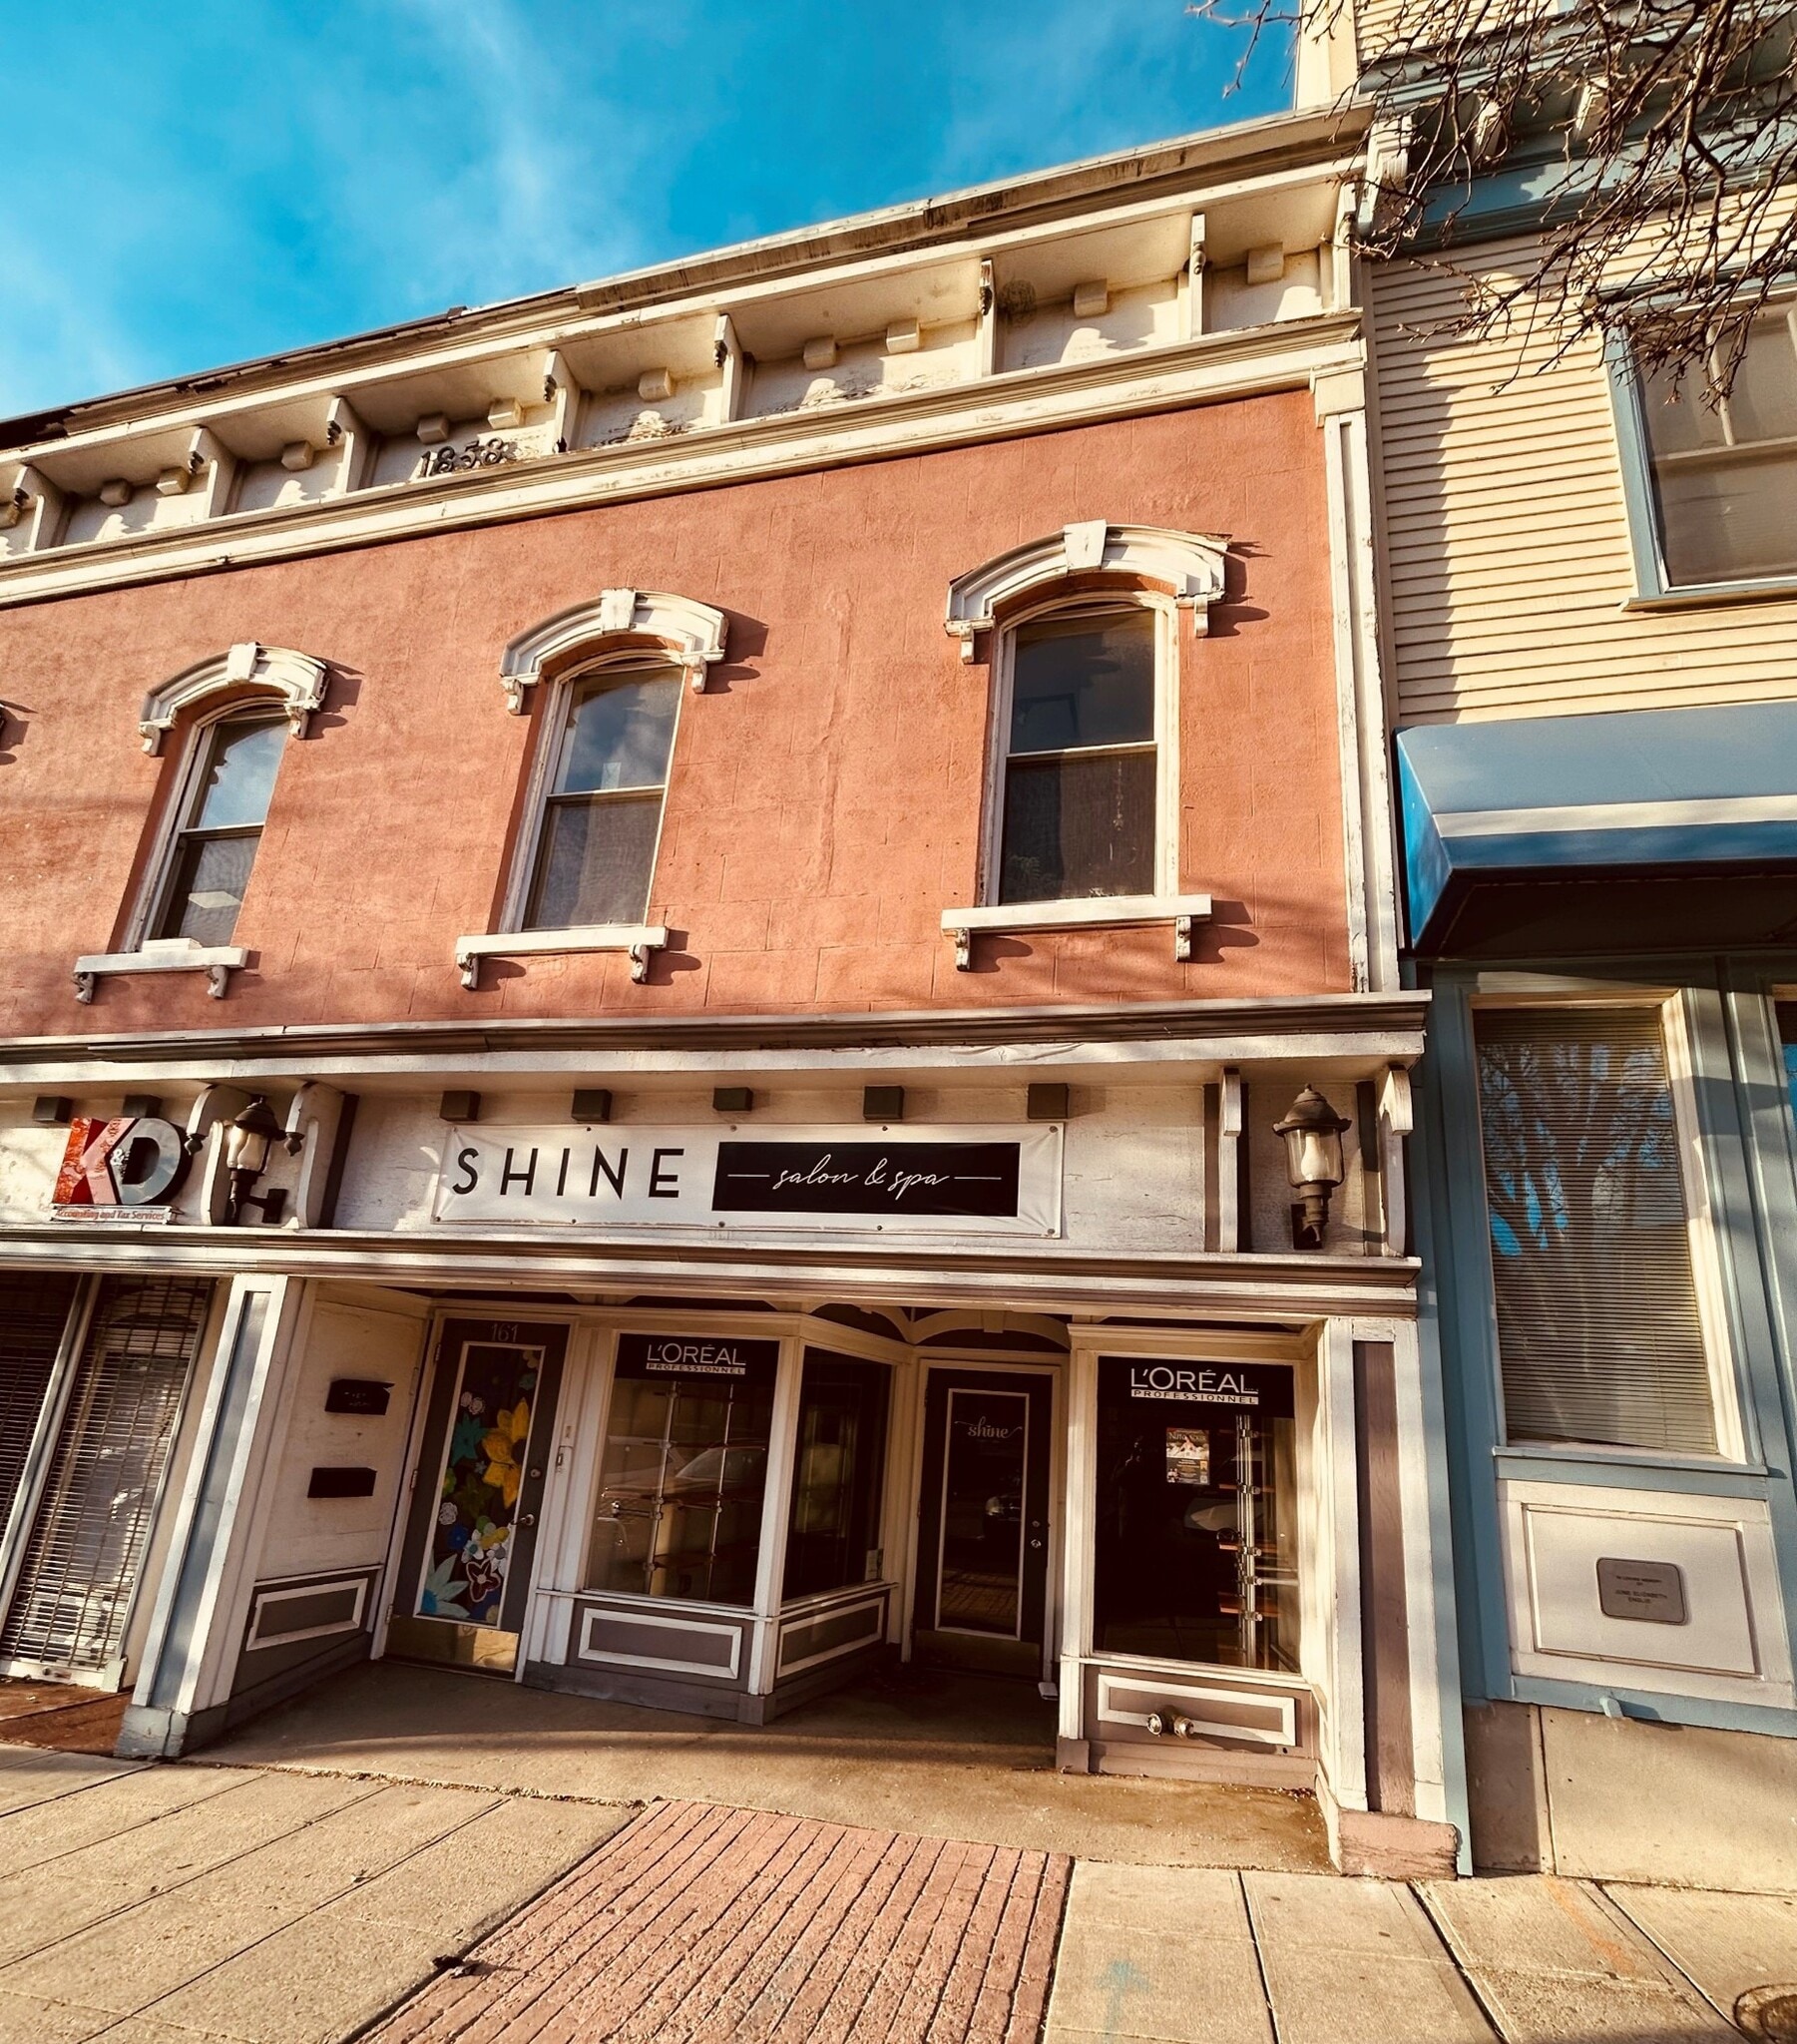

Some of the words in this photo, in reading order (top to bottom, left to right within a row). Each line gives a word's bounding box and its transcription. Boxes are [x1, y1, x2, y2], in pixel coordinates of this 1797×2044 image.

[419, 436, 504, 477] 1858
[452, 1145, 684, 1201] SHINE
[772, 1154, 859, 1190] salon
[864, 1158, 889, 1186] &
[887, 1171, 950, 1201] spa
[100, 1210, 115, 1219] and
[132, 1211, 165, 1220] Services
[491, 1322, 519, 1343] 161
[647, 1342, 746, 1365] L'ORÉAL
[647, 1362, 746, 1374] PROFESSIONNEL
[1130, 1366, 1259, 1394] L'ORÉAL
[1131, 1388, 1258, 1404] PROFESSIONNEL
[955, 1415, 1023, 1438] shine
